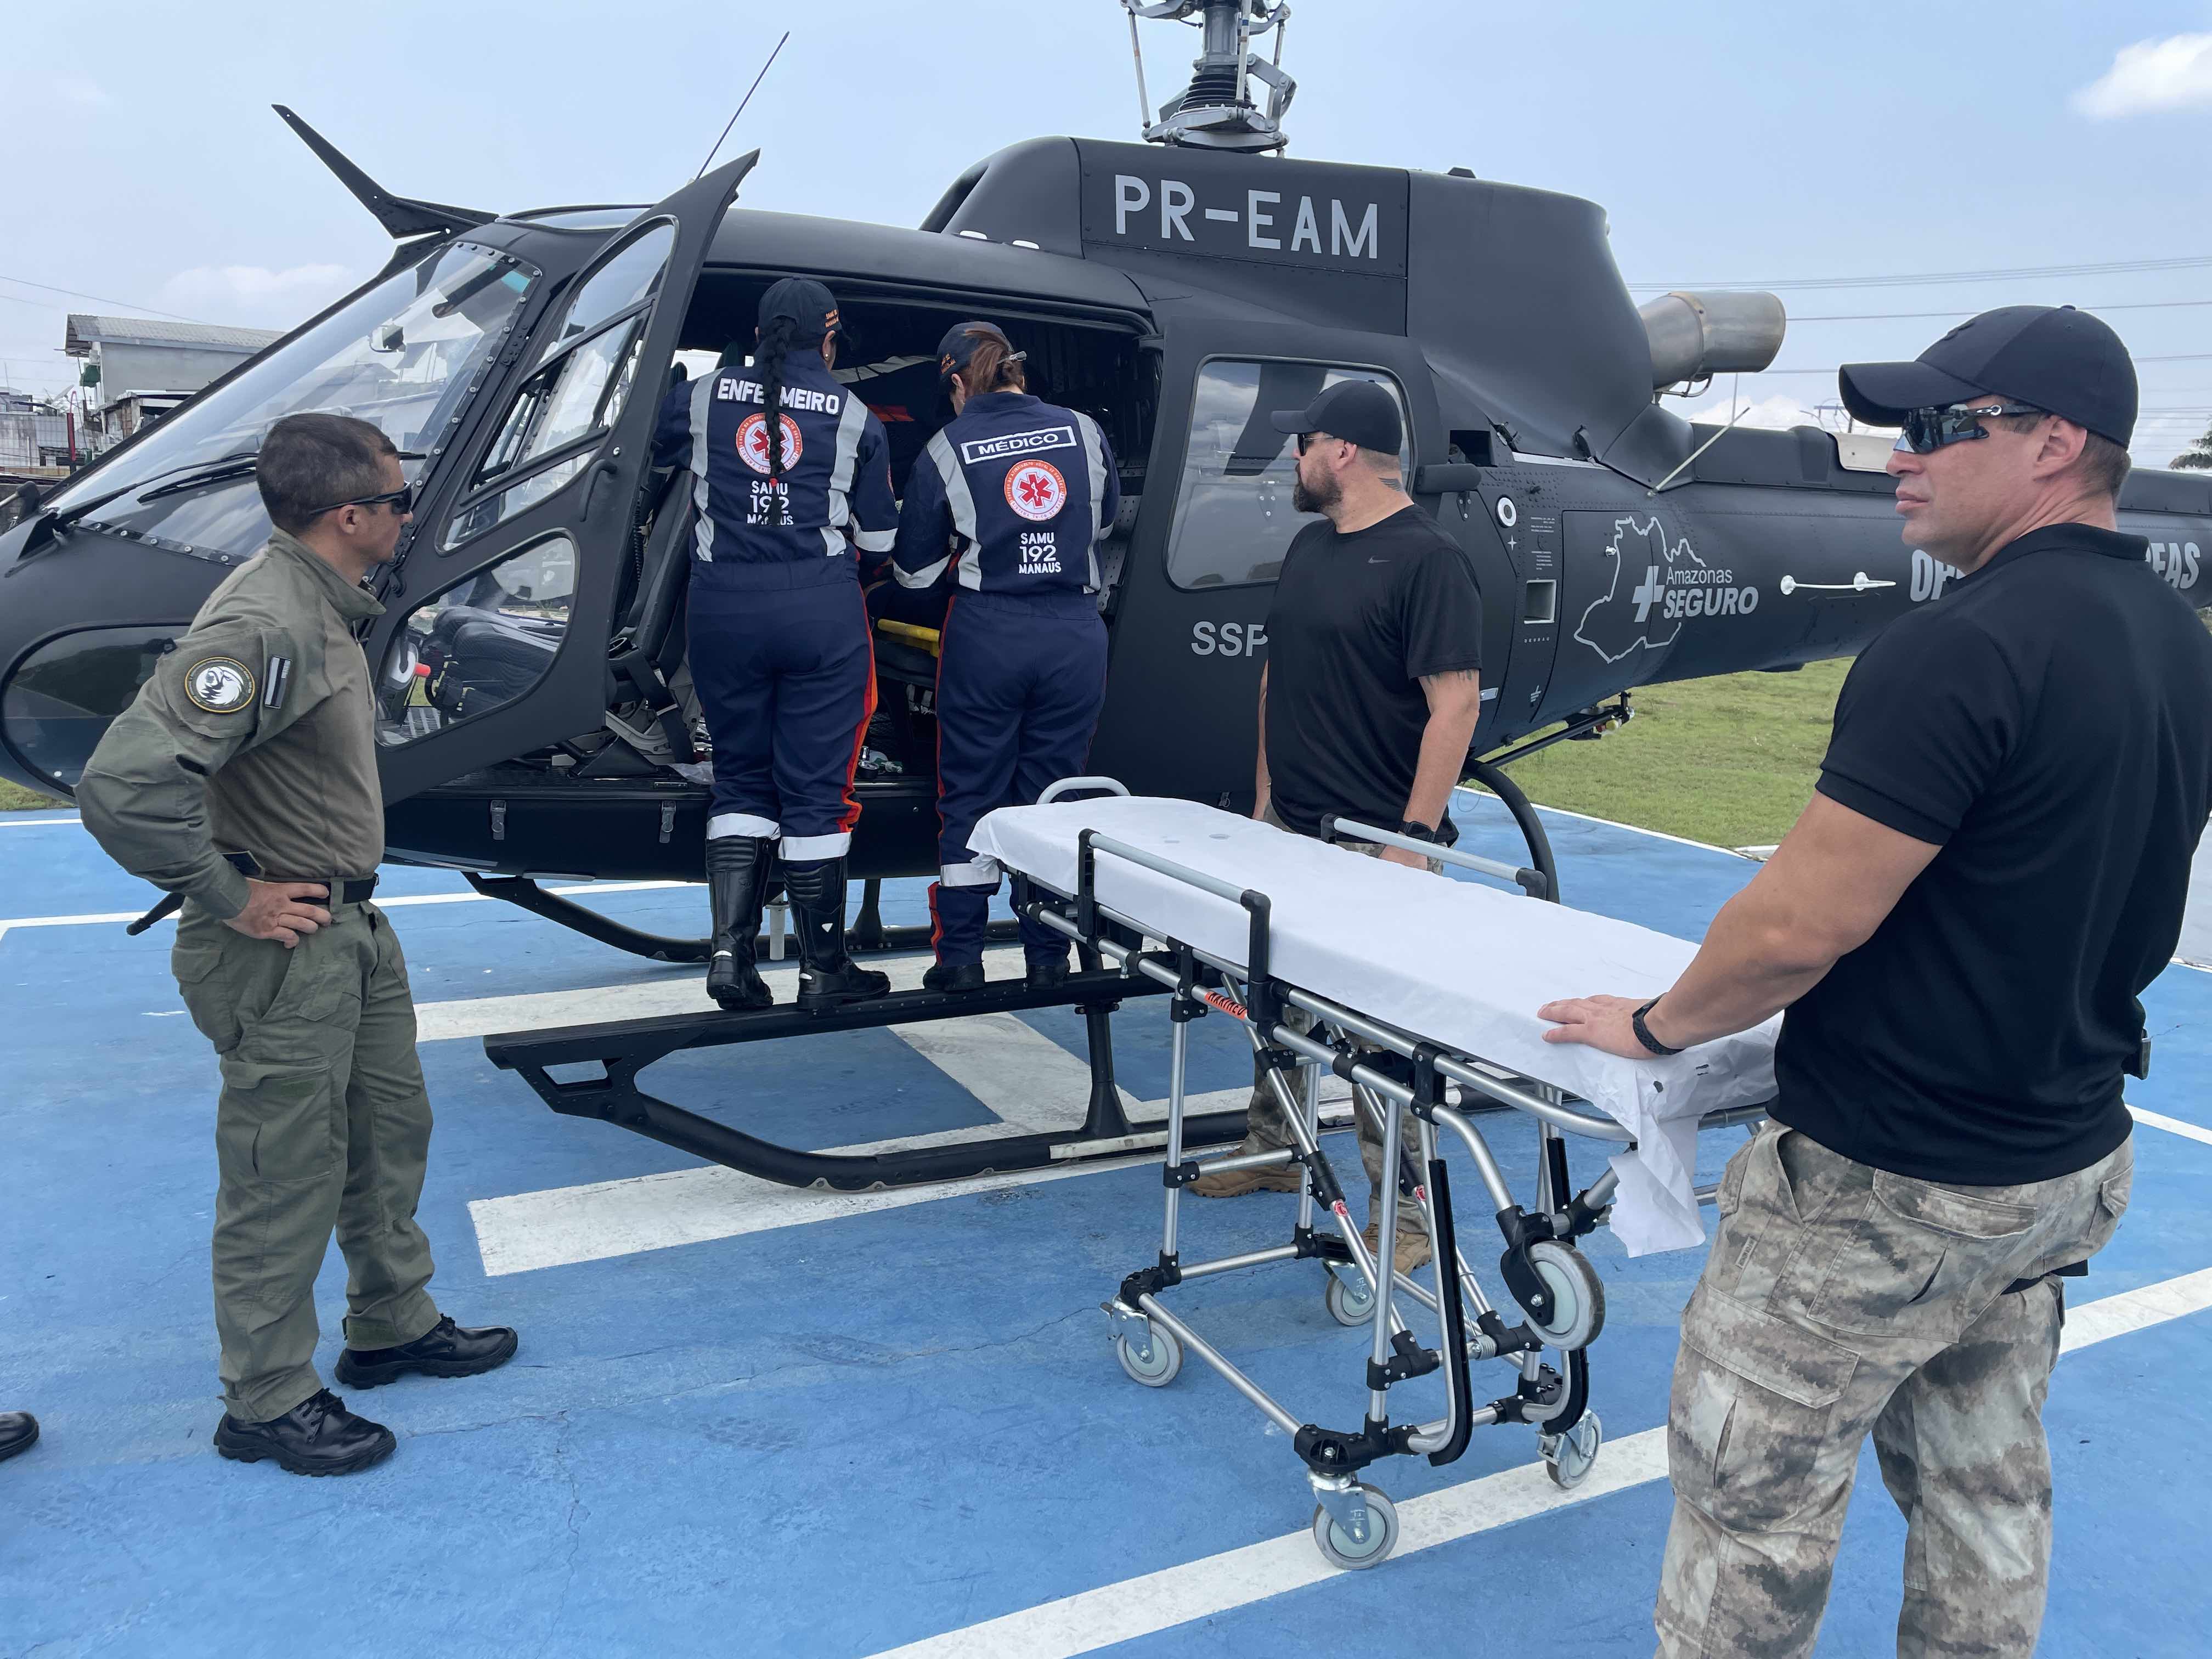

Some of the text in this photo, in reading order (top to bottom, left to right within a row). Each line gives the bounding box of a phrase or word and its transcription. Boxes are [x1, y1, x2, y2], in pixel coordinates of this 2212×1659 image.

[1115, 174, 1378, 259] PR-EAM
[717, 377, 839, 414] ENFEMEIRO
[978, 433, 1058, 454] MÉDICO
[750, 495, 789, 514] 192
[1020, 532, 1054, 544] SAMU
[1019, 545, 1056, 563] 192
[1019, 562, 1062, 574] MANAUS
[1666, 566, 1733, 585] Amazonas
[1663, 586, 1759, 619] SEGURO
